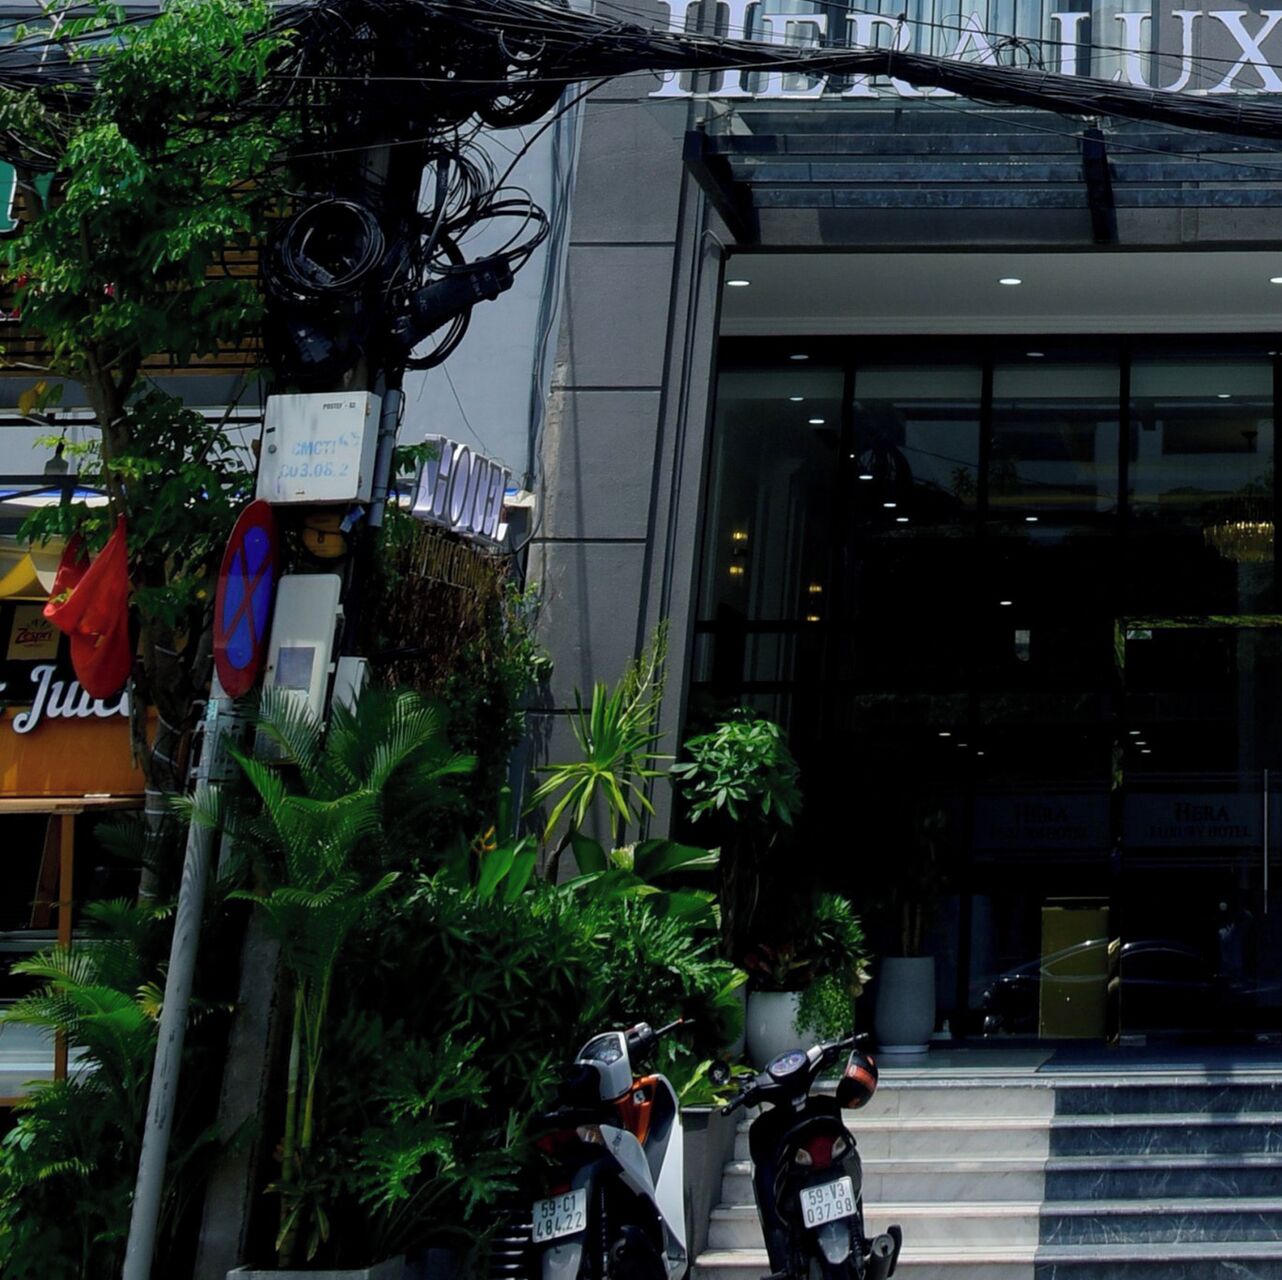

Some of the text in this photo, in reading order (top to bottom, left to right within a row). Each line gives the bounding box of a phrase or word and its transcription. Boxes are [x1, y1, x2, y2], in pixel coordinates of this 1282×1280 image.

[541, 1195, 576, 1217] 59-C1
[808, 1183, 846, 1206] 59-V3
[806, 1199, 853, 1224] 037.98
